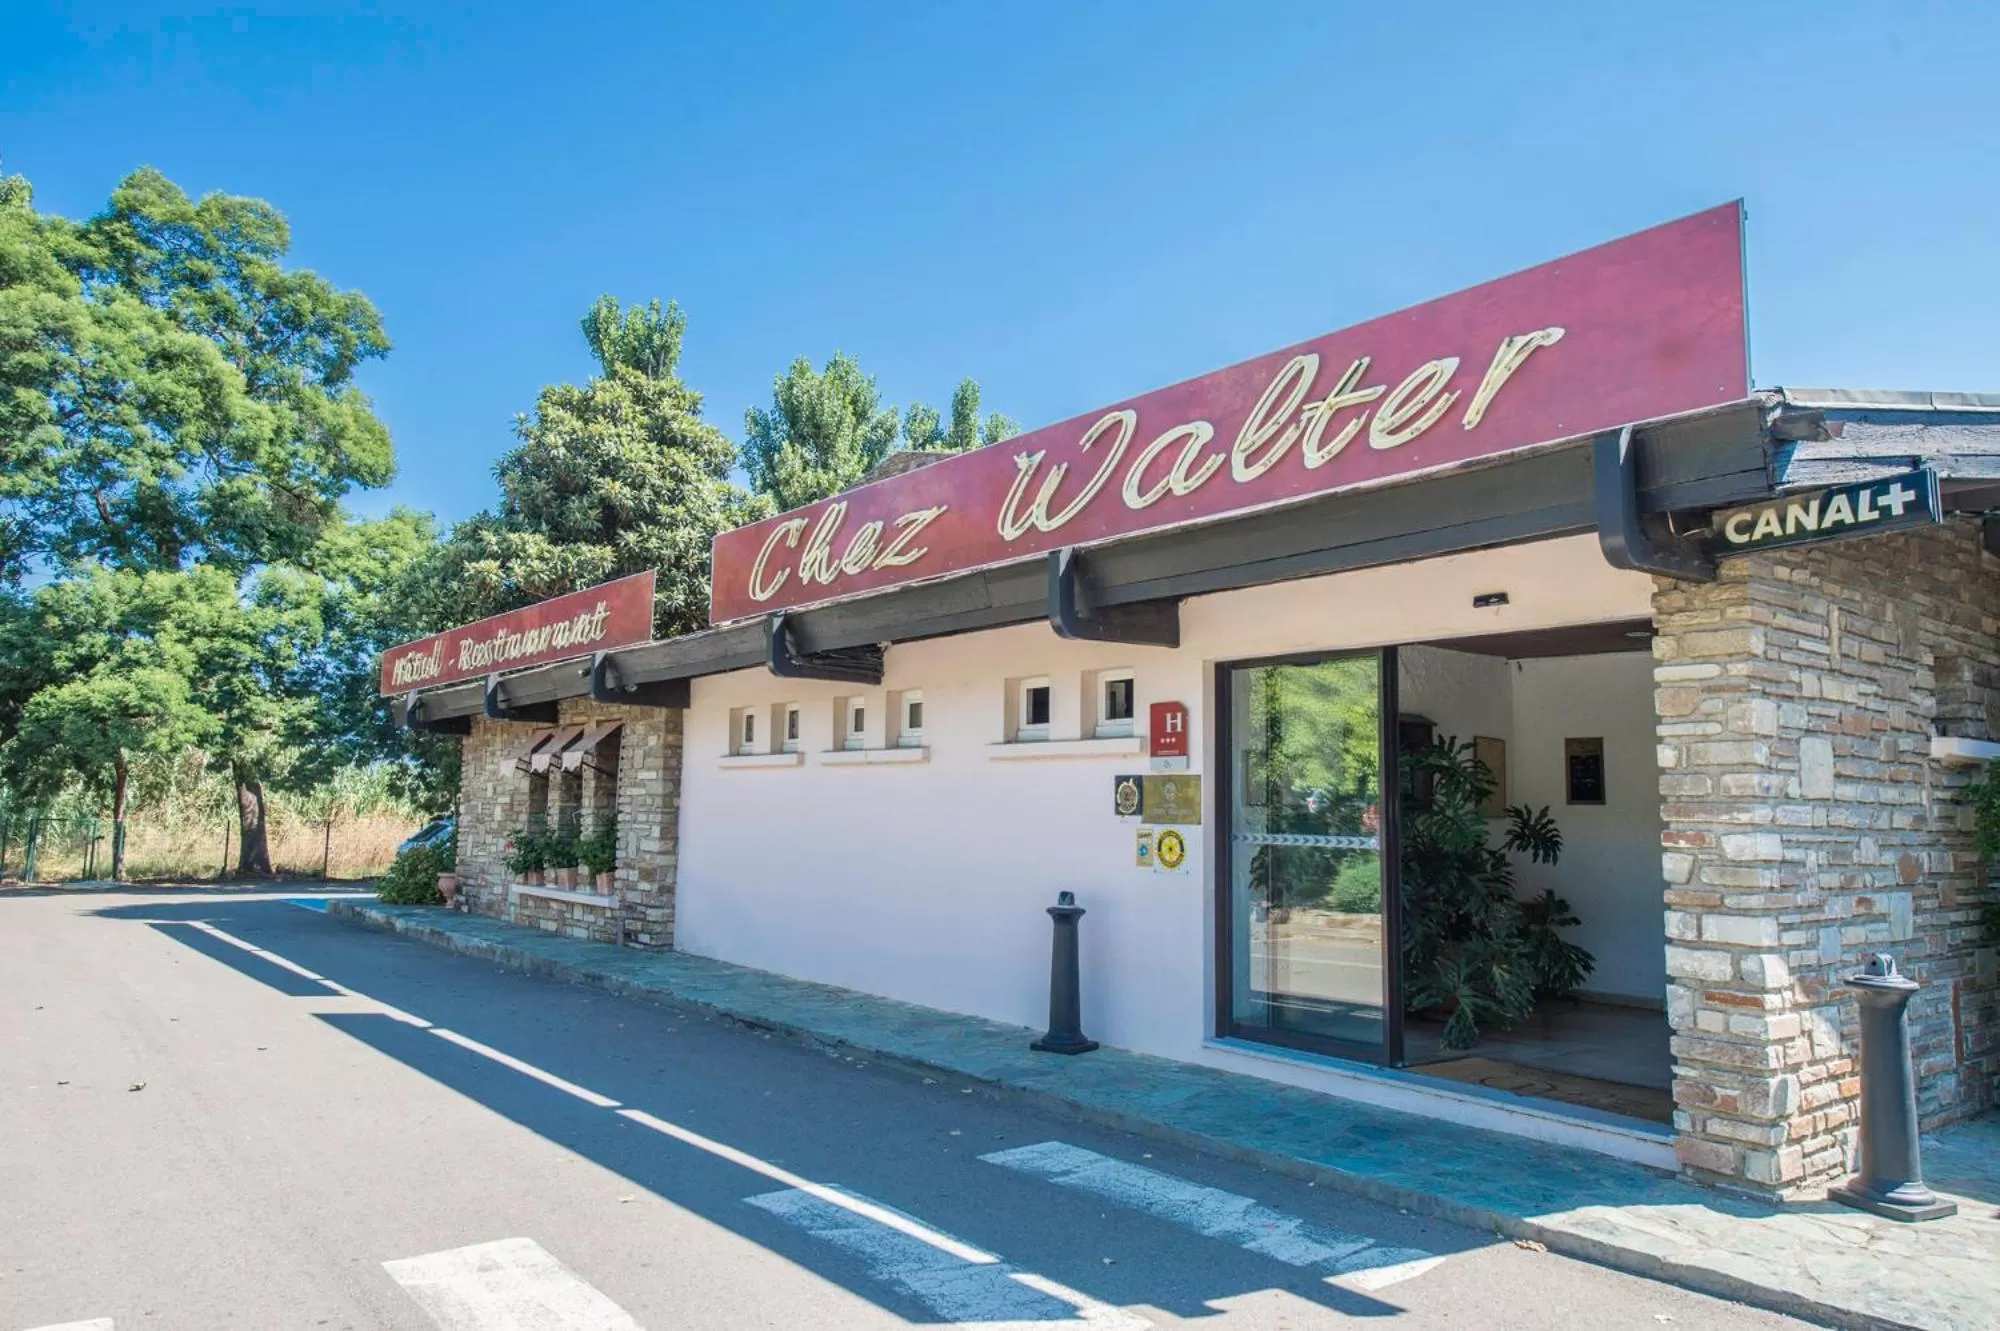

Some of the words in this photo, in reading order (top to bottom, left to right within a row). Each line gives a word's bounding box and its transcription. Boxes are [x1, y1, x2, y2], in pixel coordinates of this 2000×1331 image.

[749, 500, 948, 601] Chez
[996, 327, 1566, 541] Walter
[1725, 483, 1916, 543] CANAL+
[458, 600, 611, 671] Restaurant
[1165, 712, 1183, 733] H
